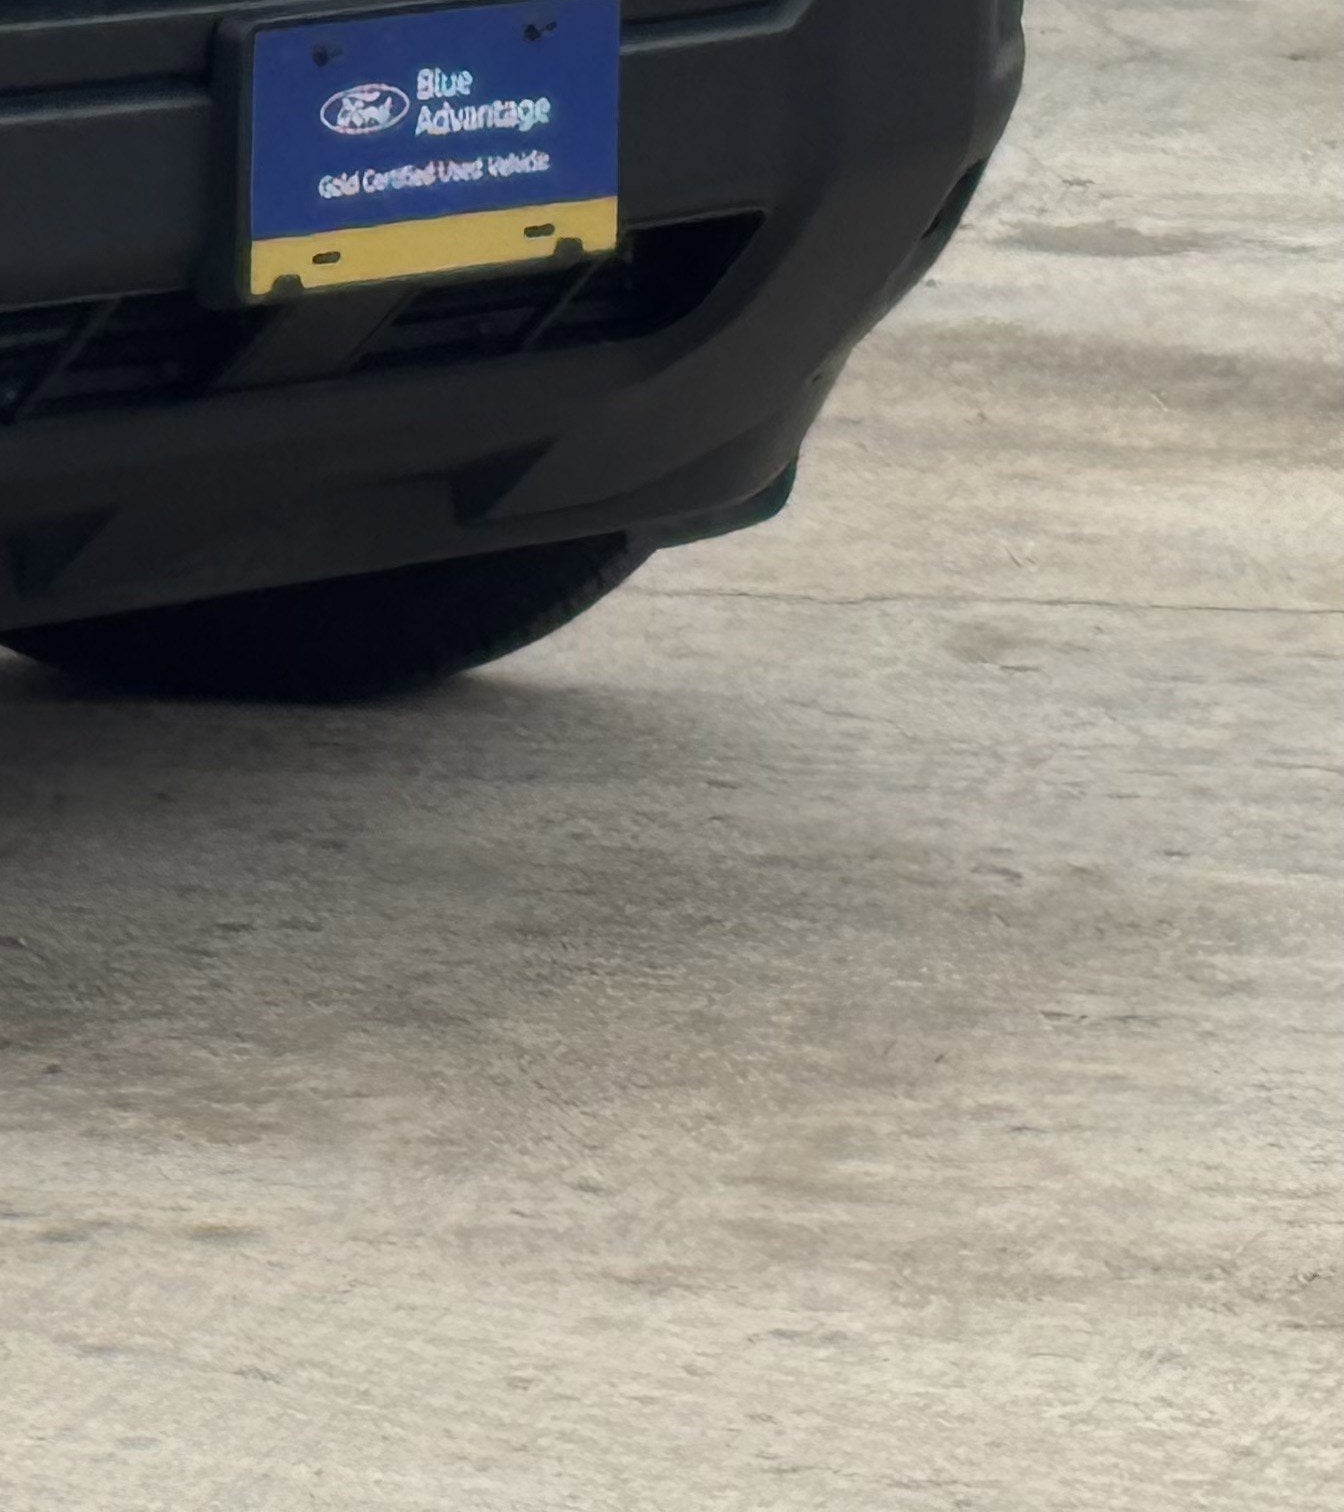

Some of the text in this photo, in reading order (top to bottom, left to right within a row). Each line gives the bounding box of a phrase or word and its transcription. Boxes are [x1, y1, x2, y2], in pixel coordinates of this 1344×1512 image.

[416, 67, 473, 100] Blue
[415, 97, 551, 136] Advantage
[318, 171, 360, 199] Gold
[438, 157, 483, 182] Used
[488, 150, 550, 177] Vehicle
